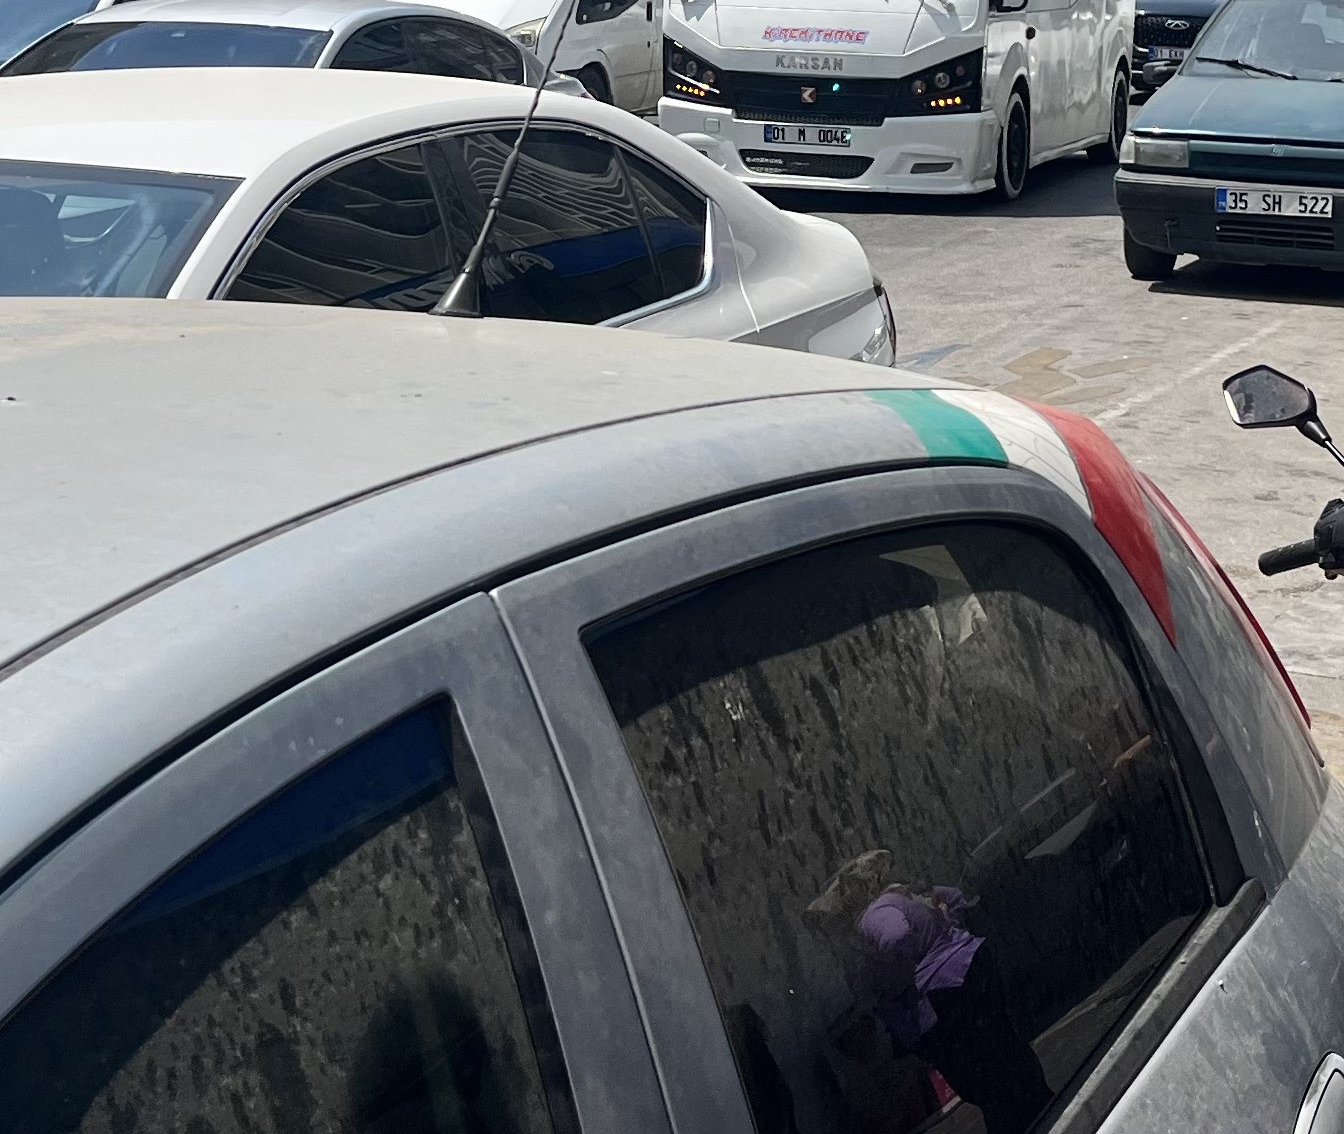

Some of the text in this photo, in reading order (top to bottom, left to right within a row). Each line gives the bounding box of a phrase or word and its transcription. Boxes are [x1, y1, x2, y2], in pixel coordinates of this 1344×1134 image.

[775, 55, 844, 71] KARSAN
[772, 127, 785, 141] 01
[1228, 192, 1330, 215] 35 SH 522
